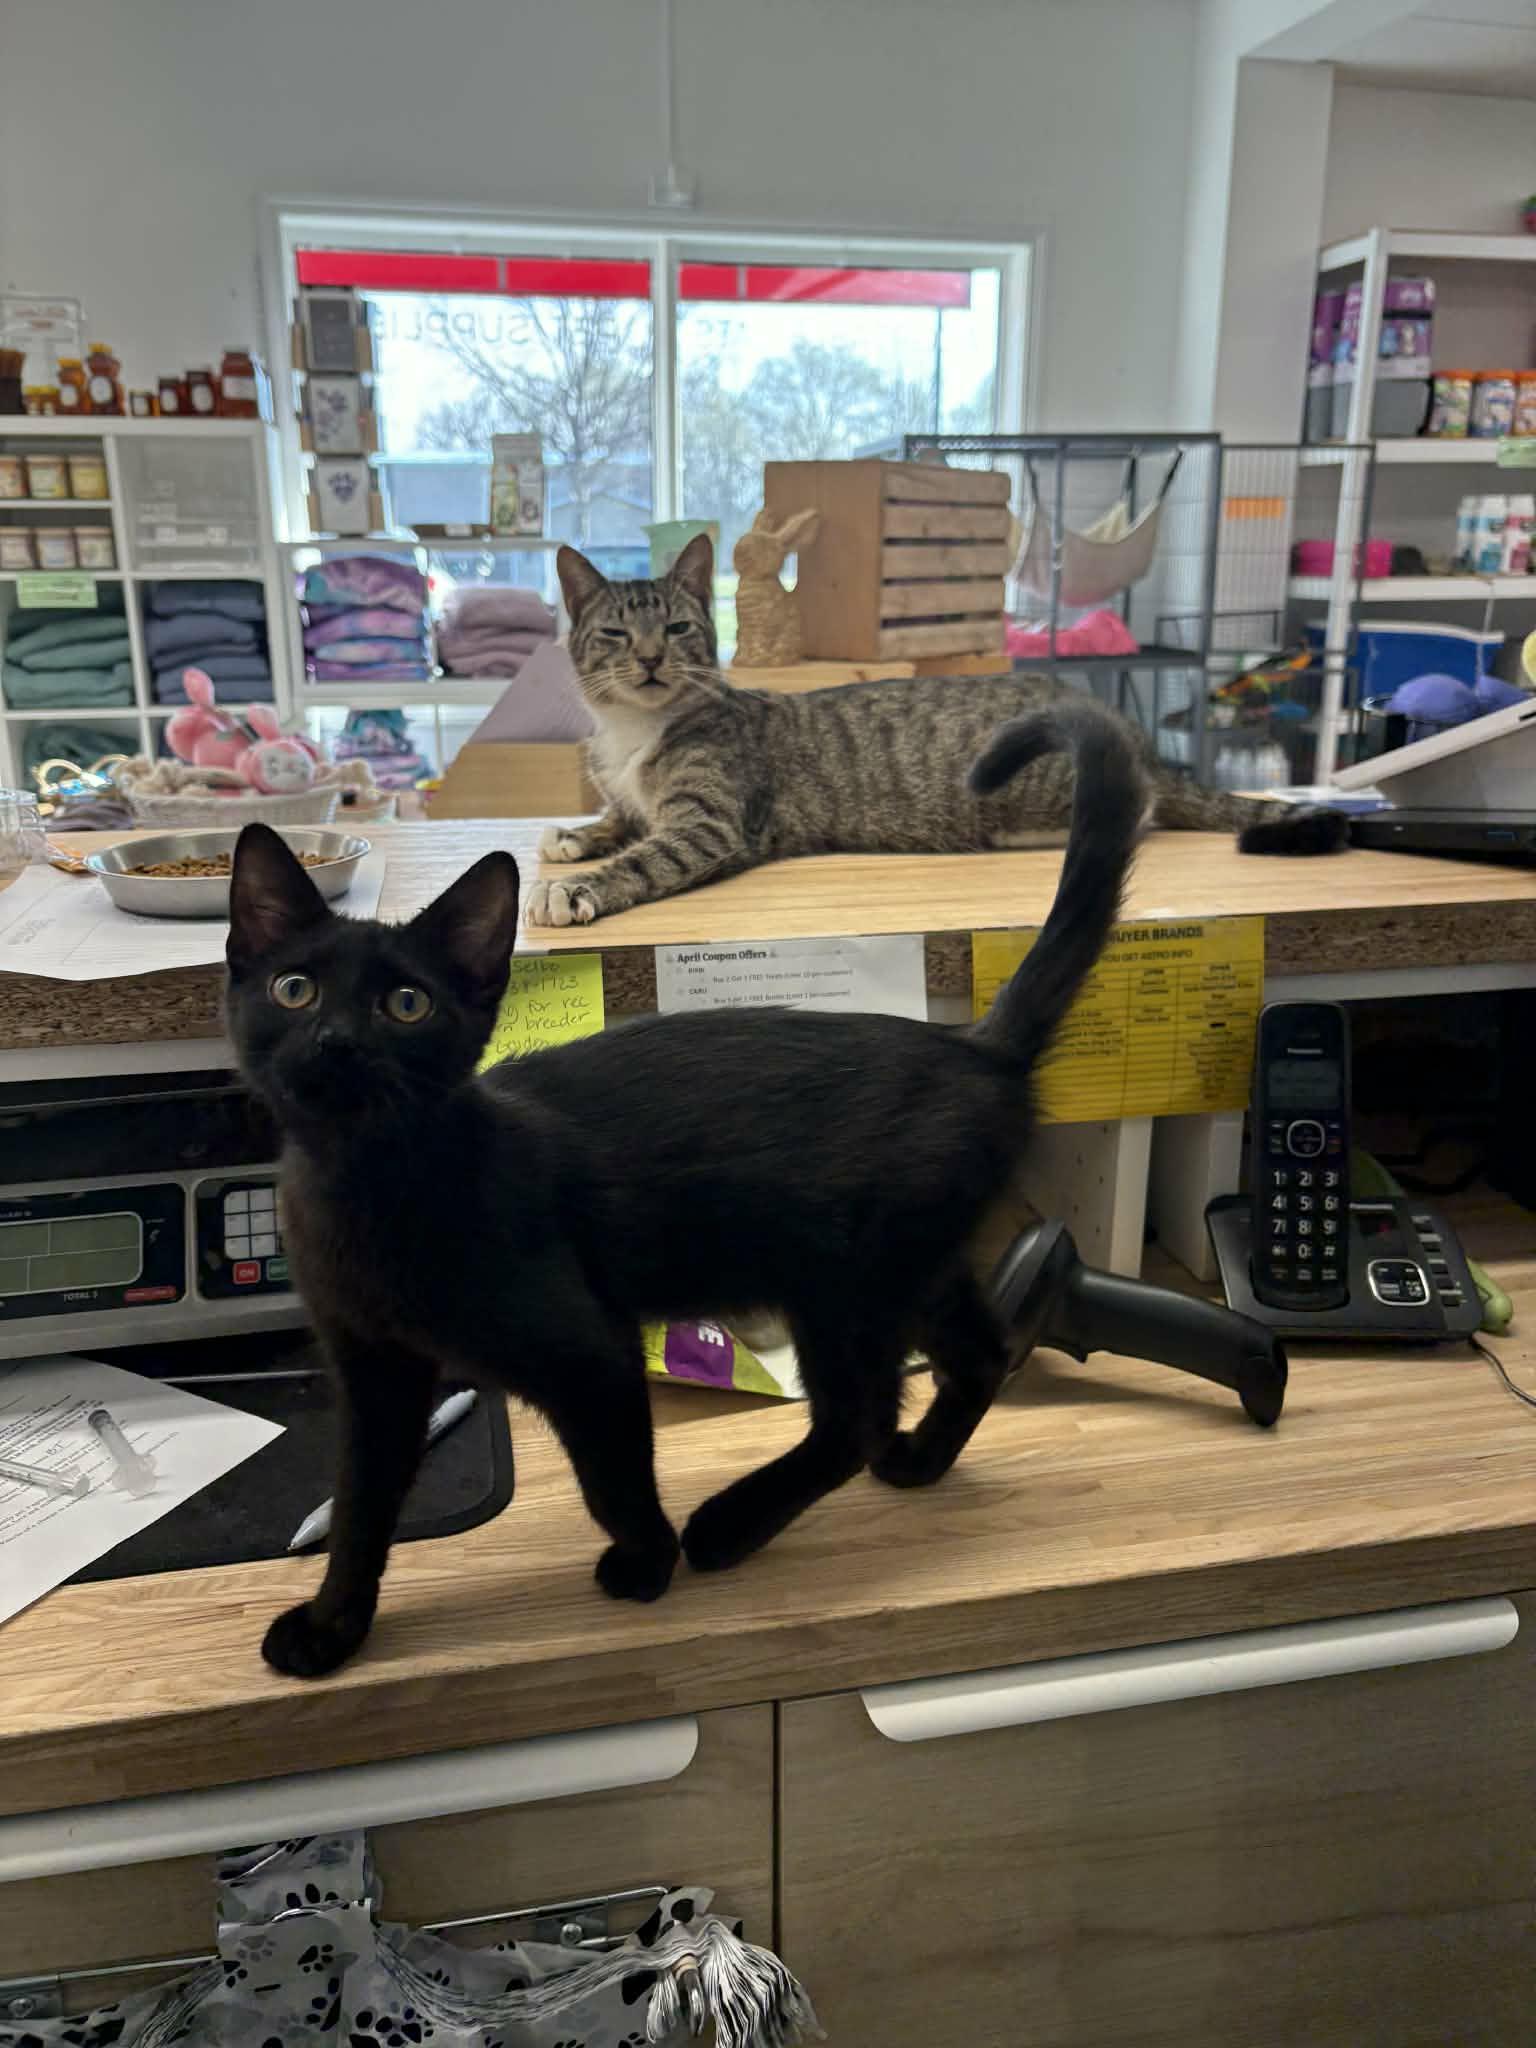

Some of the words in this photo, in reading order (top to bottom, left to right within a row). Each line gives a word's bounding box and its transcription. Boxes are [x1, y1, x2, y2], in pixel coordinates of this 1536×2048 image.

[1151, 926, 1203, 940] BRANDS
[678, 952, 700, 964] April
[703, 951, 737, 963] Coupon
[739, 949, 766, 960] Offers
[524, 1011, 591, 1032] breeder
